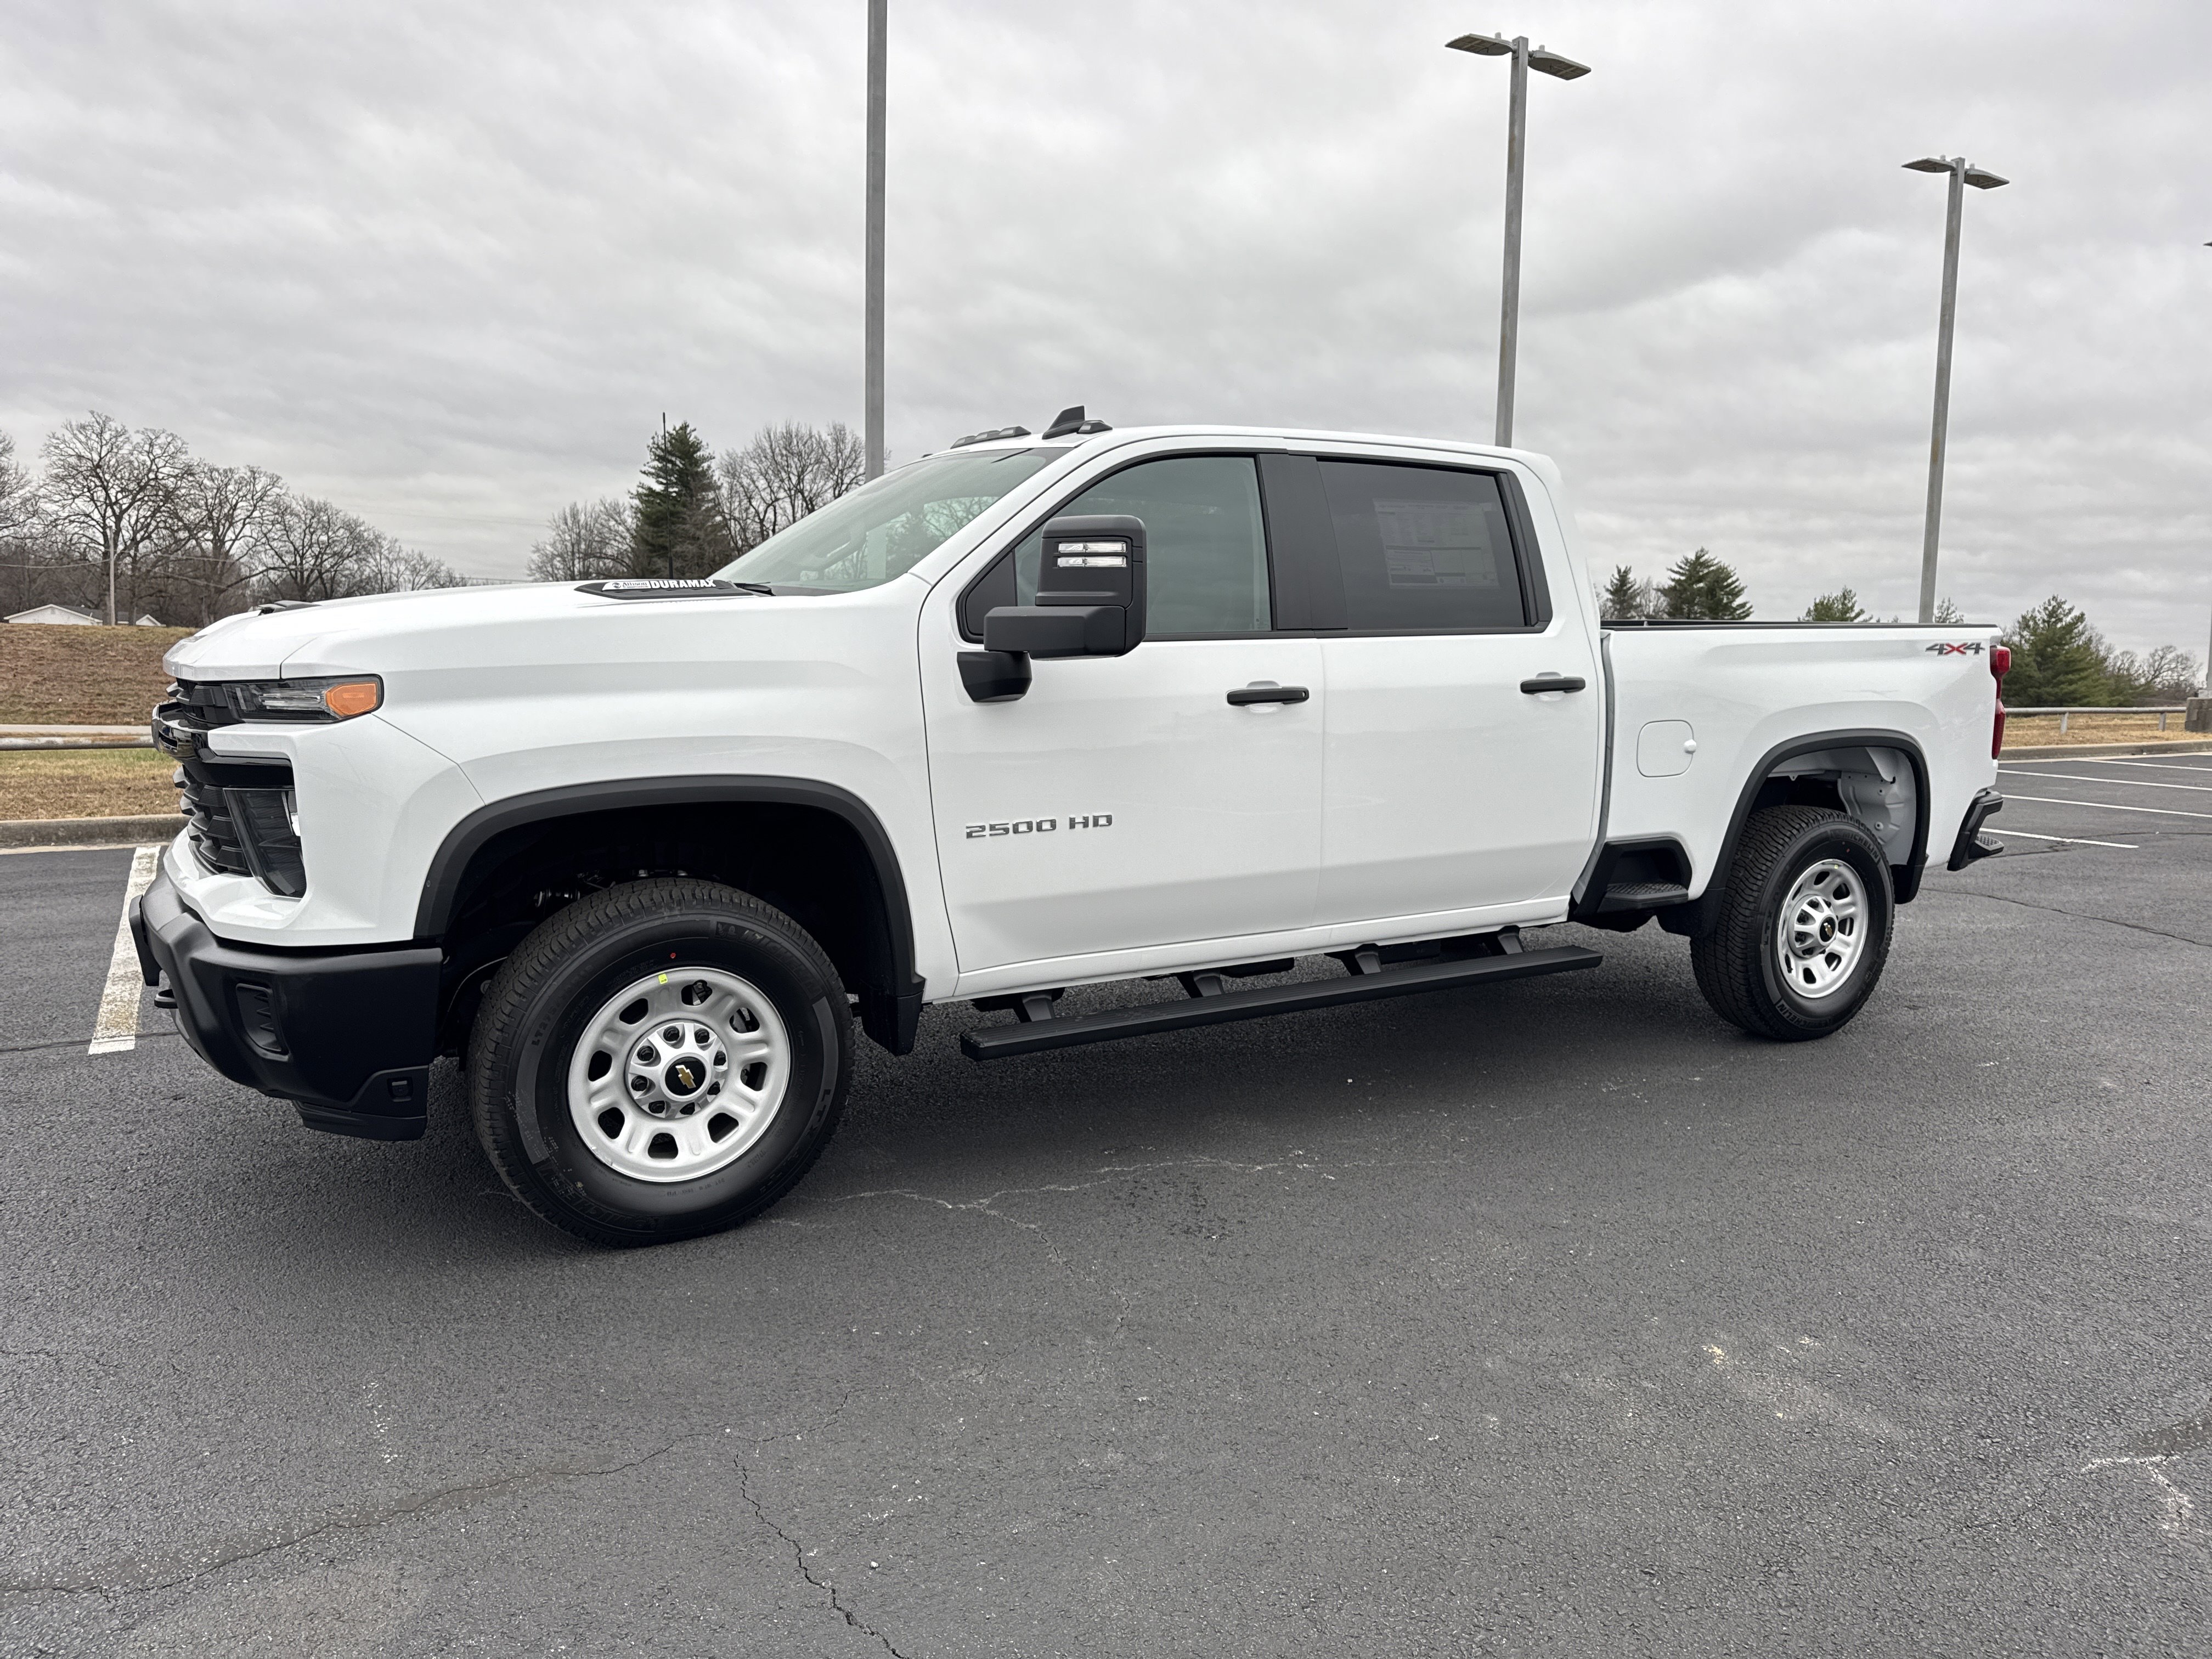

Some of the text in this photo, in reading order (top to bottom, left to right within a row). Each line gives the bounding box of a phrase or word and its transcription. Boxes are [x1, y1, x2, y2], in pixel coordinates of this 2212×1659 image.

[650, 579, 716, 589] DURAMAX
[1925, 642, 1985, 656] 4X4
[966, 814, 1113, 839] 2500 HD
[1843, 834, 1879, 860] MICHELIN
[1764, 910, 1773, 945] LTX
[742, 929, 822, 998] MICHELIN
[805, 1089, 831, 1135] LTX
